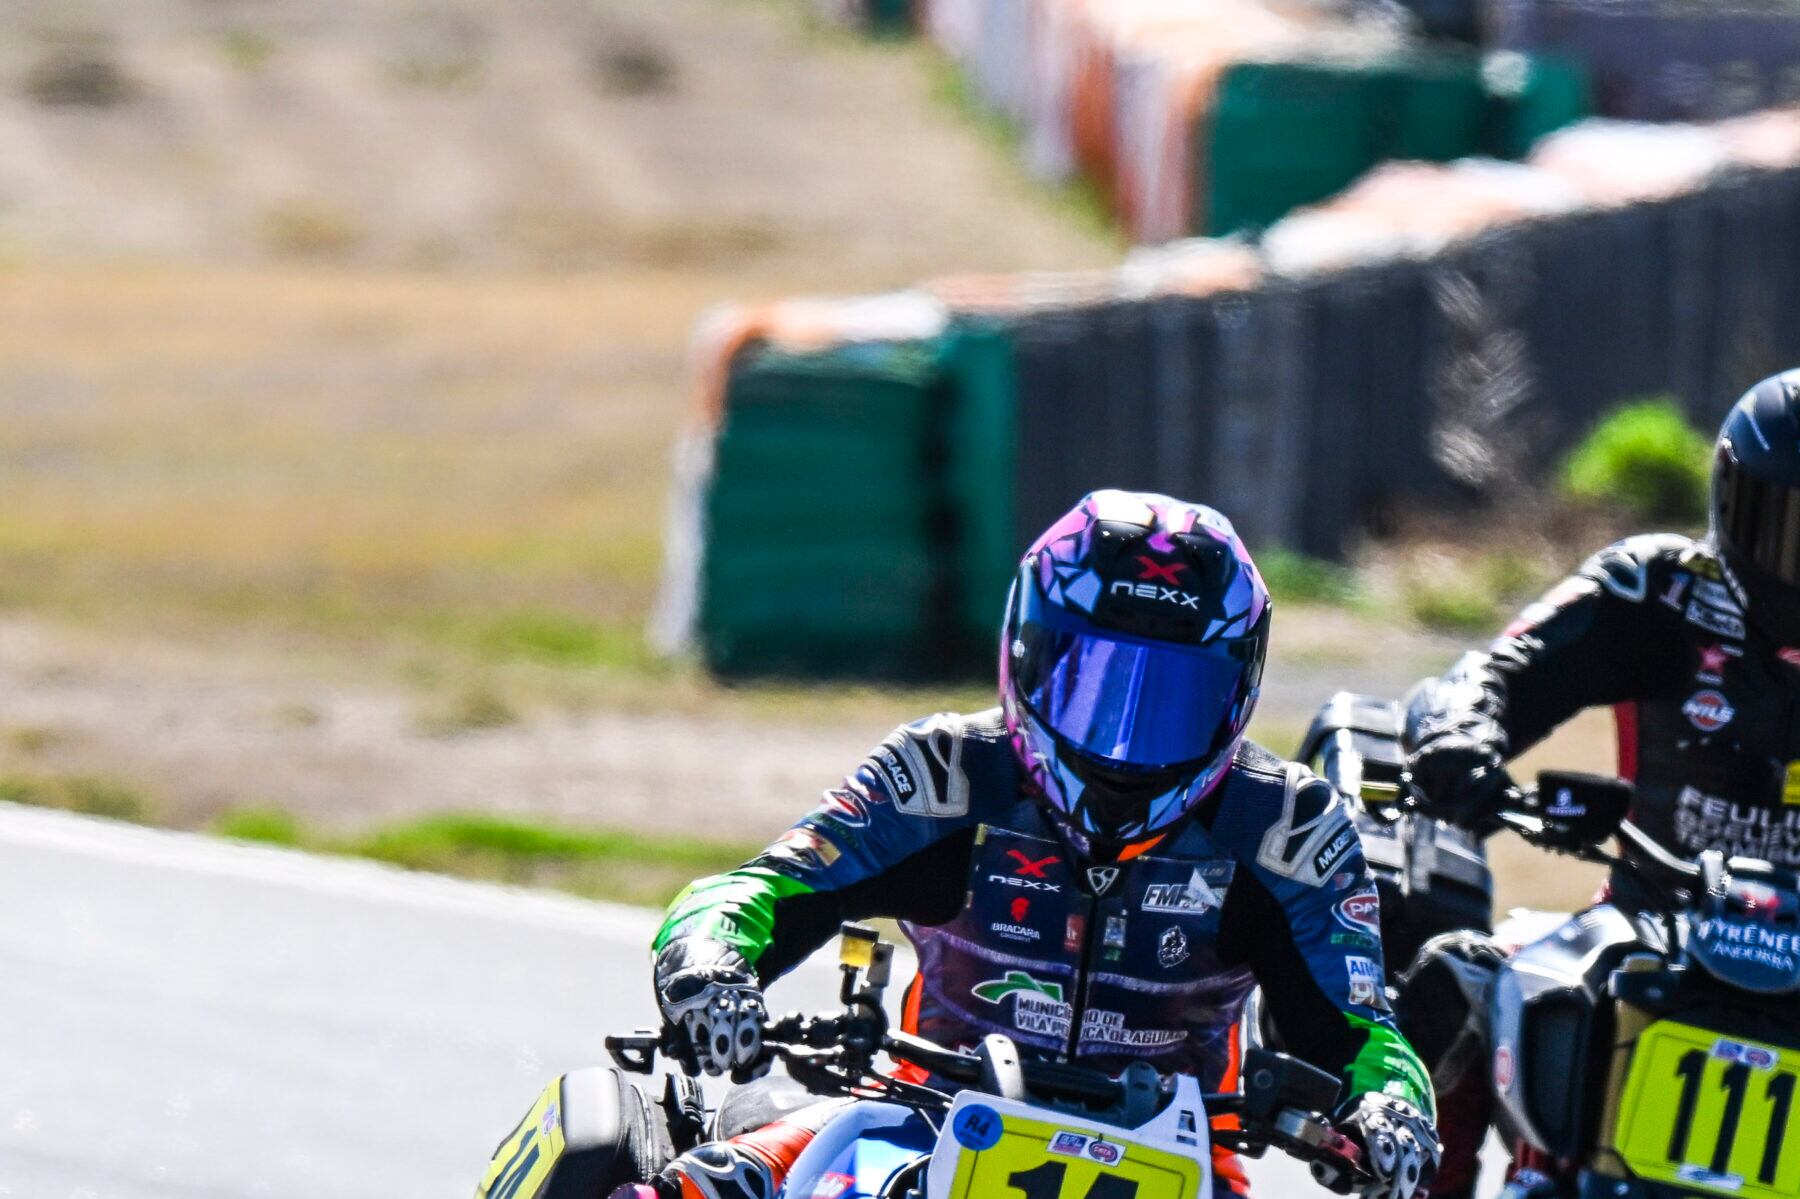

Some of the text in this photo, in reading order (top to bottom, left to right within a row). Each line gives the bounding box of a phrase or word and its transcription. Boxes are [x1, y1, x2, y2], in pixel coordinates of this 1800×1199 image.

[1318, 831, 1351, 869] MUGE
[991, 922, 1040, 940] BRACARA
[1713, 940, 1795, 972] ANDORRA
[1667, 1048, 1797, 1185] 111
